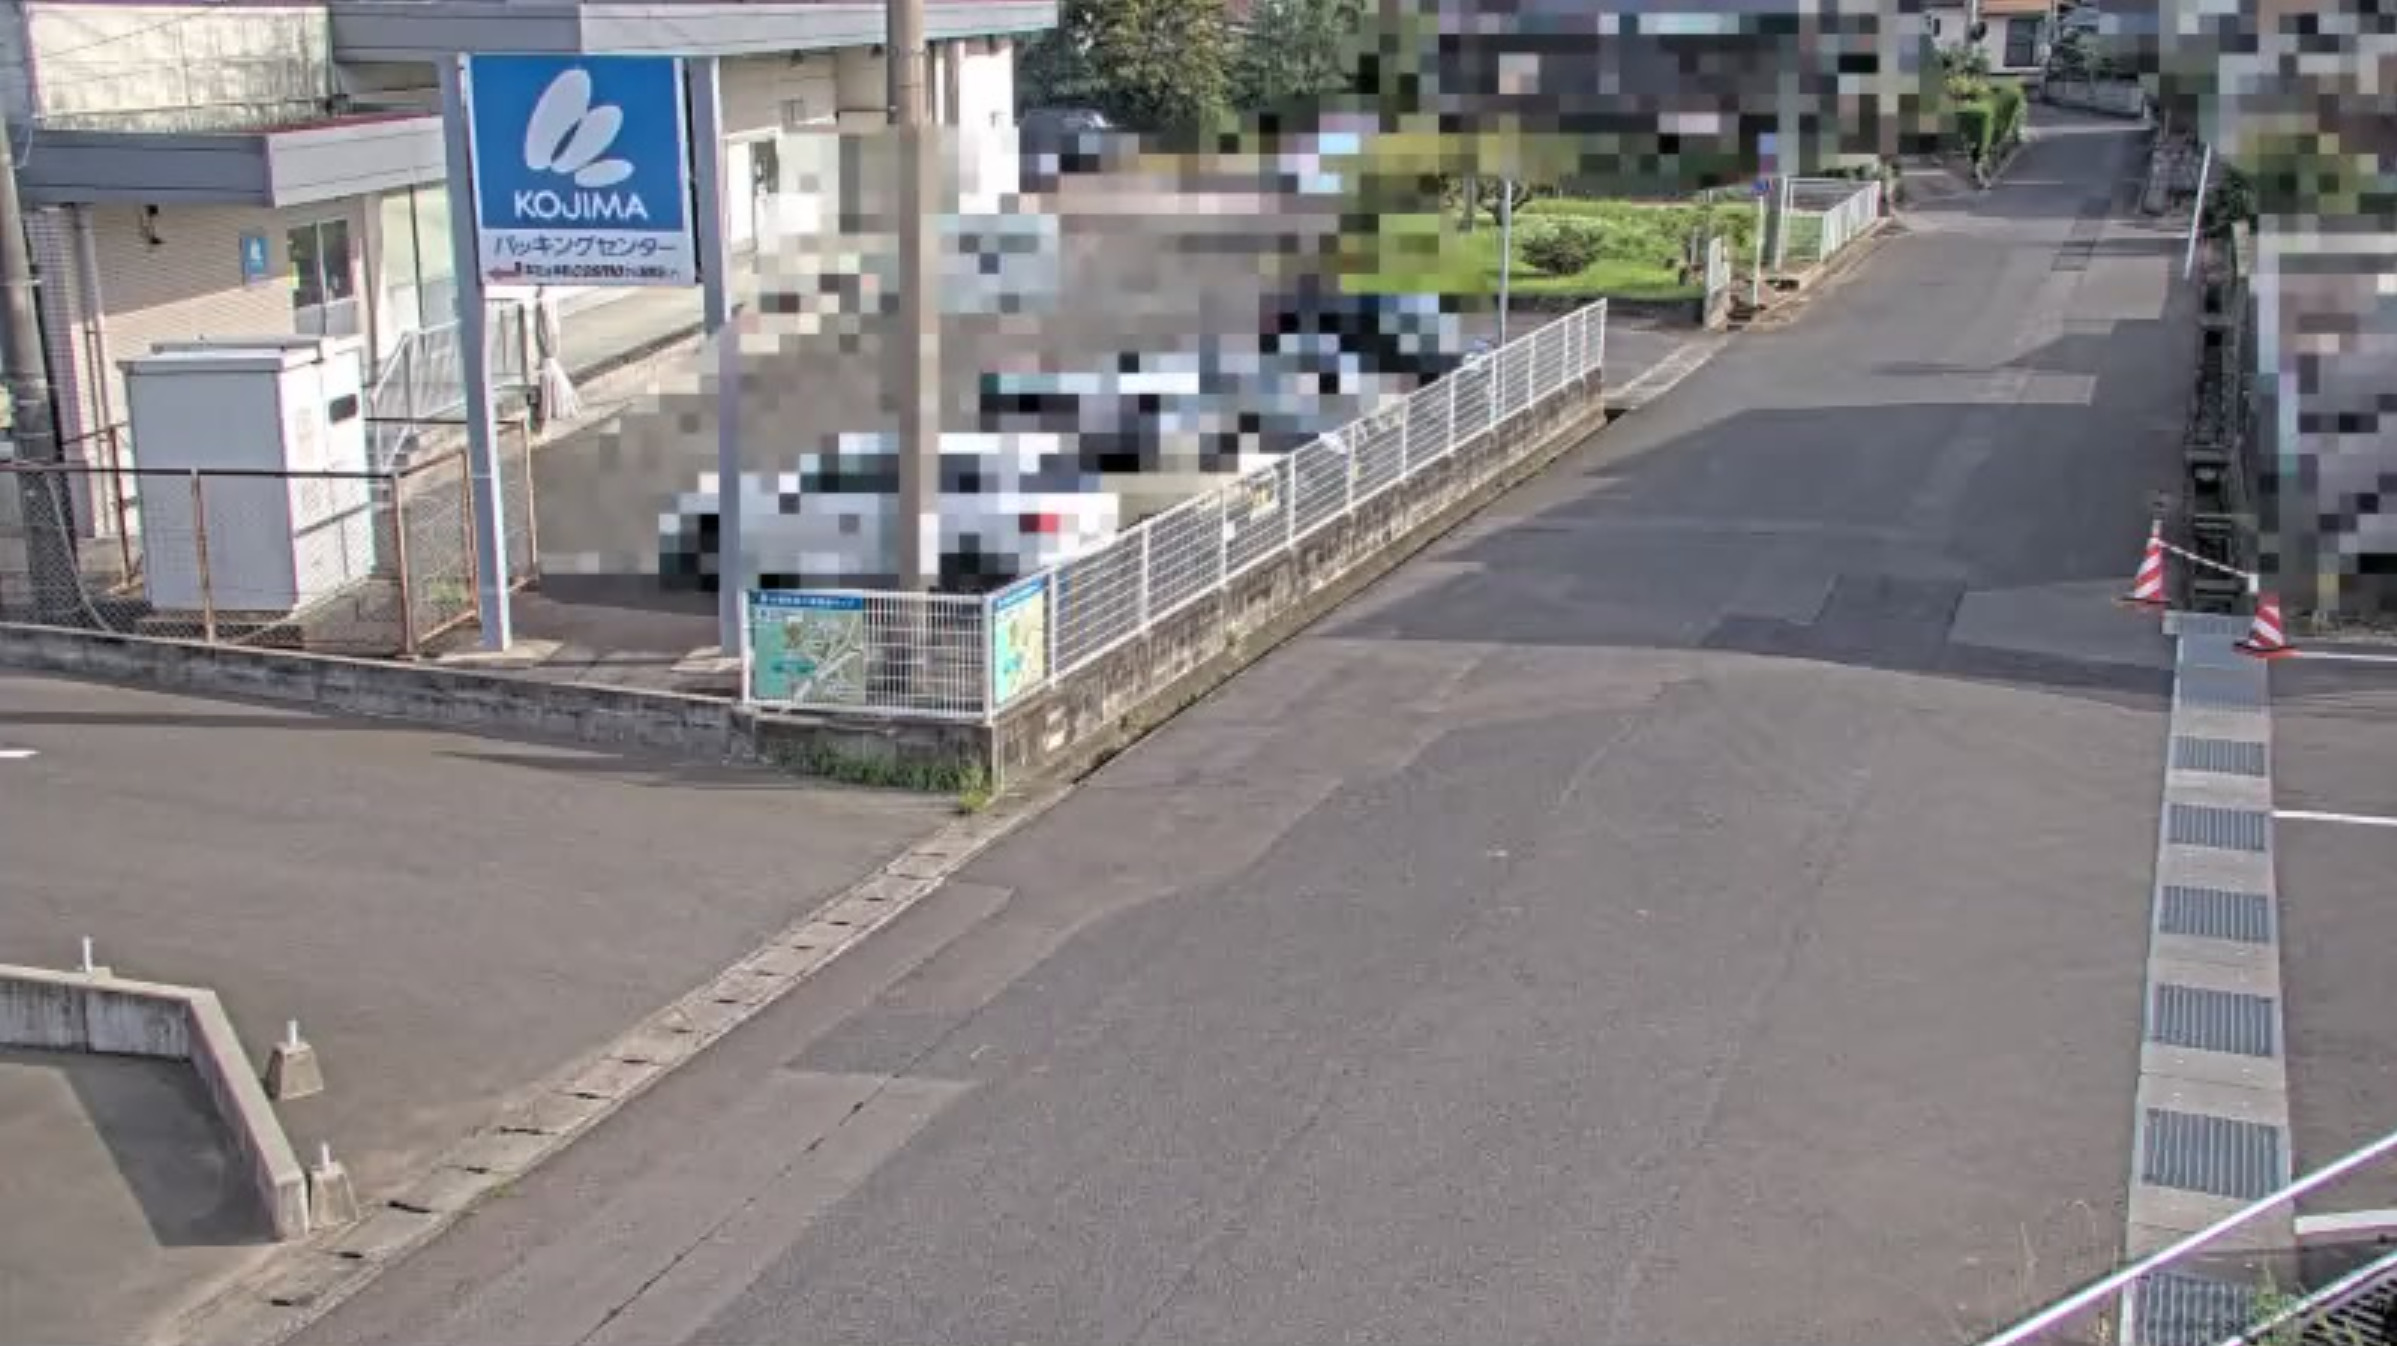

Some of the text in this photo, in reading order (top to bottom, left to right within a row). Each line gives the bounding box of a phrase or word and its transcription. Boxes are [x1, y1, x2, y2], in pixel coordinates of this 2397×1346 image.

[514, 190, 648, 219] KOJIMA
[494, 235, 676, 257] パッキングセンター
